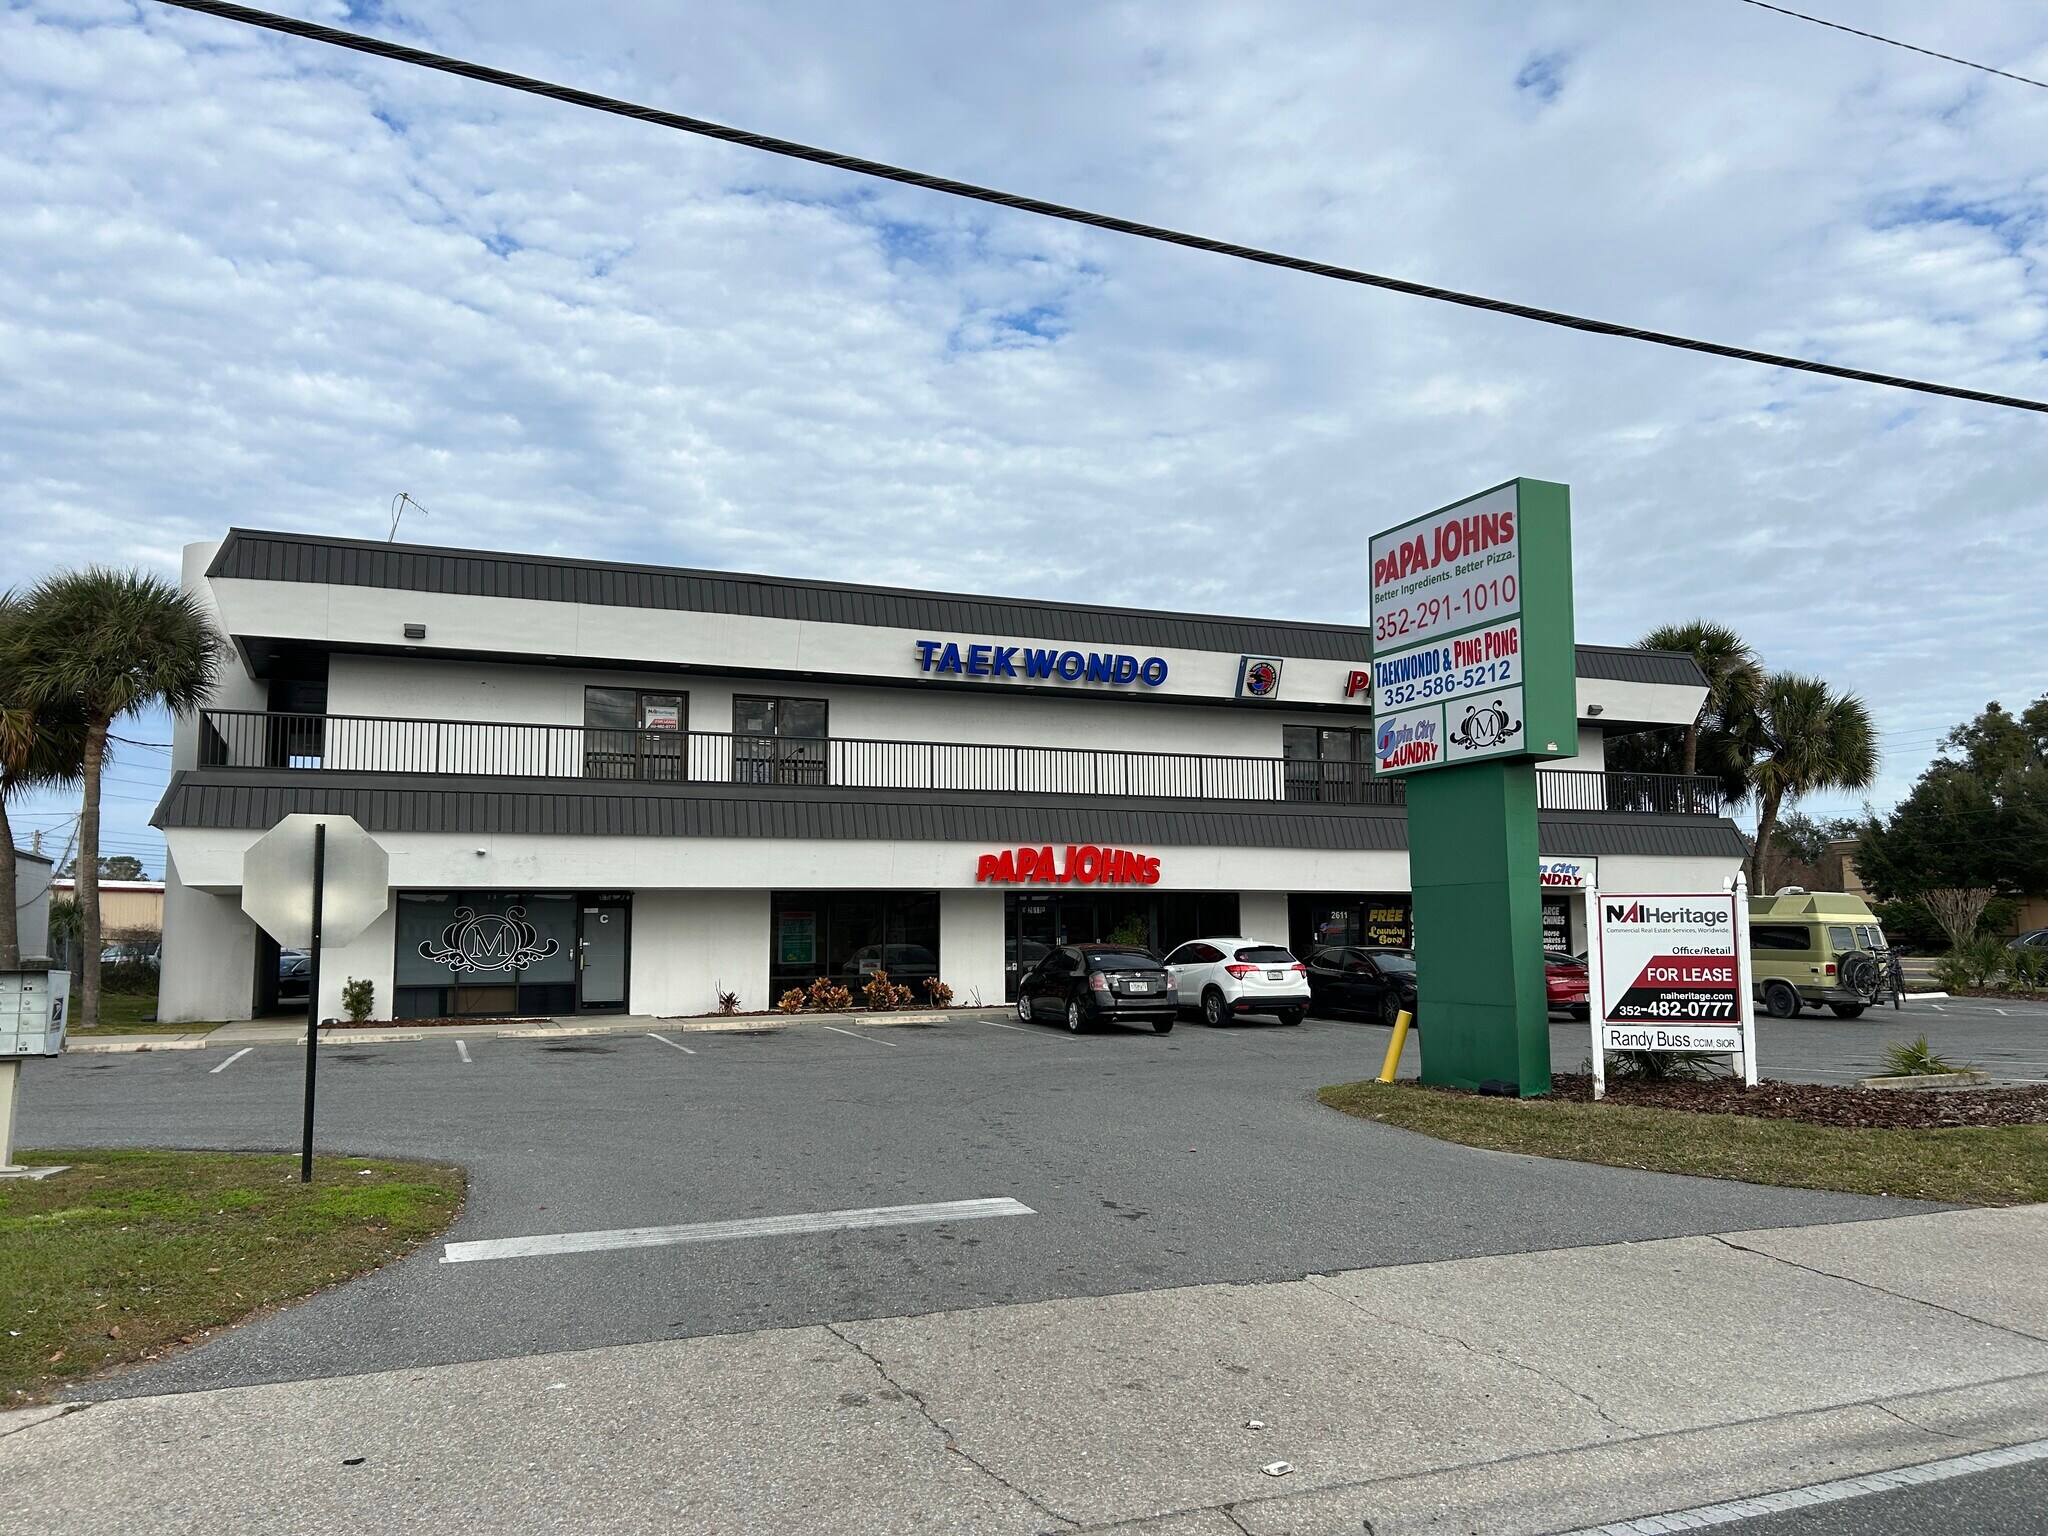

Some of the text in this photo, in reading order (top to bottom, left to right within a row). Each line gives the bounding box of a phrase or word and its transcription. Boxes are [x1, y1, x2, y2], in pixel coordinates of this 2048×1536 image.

[1374, 512, 1514, 588] PAPA JOHNS
[1374, 551, 1516, 604] Better Ingredients. Better Pizza.
[1375, 574, 1516, 641] 352-291-1010
[915, 639, 1169, 687] TAEKWONDO
[1375, 627, 1518, 689] TAEKWONDO & PING PONG
[1384, 659, 1511, 707] 352-586-5212
[1323, 731, 1328, 739] E
[1415, 720, 1436, 742] City
[1474, 714, 1496, 740] M
[1382, 741, 1439, 769] LAUNDRY
[976, 845, 1161, 885] PAPA JOHNS
[1550, 862, 1580, 876] City
[600, 914, 608, 923] C
[1331, 911, 1348, 919] 2611
[1368, 909, 1404, 922] FREE
[1368, 925, 1406, 939] Laundry
[1672, 927, 1697, 935] Services,
[1697, 927, 1731, 935] Worldwide.
[1672, 946, 1731, 955] Office/Retail
[1647, 967, 1733, 982] FOR LEASE
[1619, 1001, 1733, 1017] 352-482-0777
[1610, 1030, 1653, 1050] Randy
